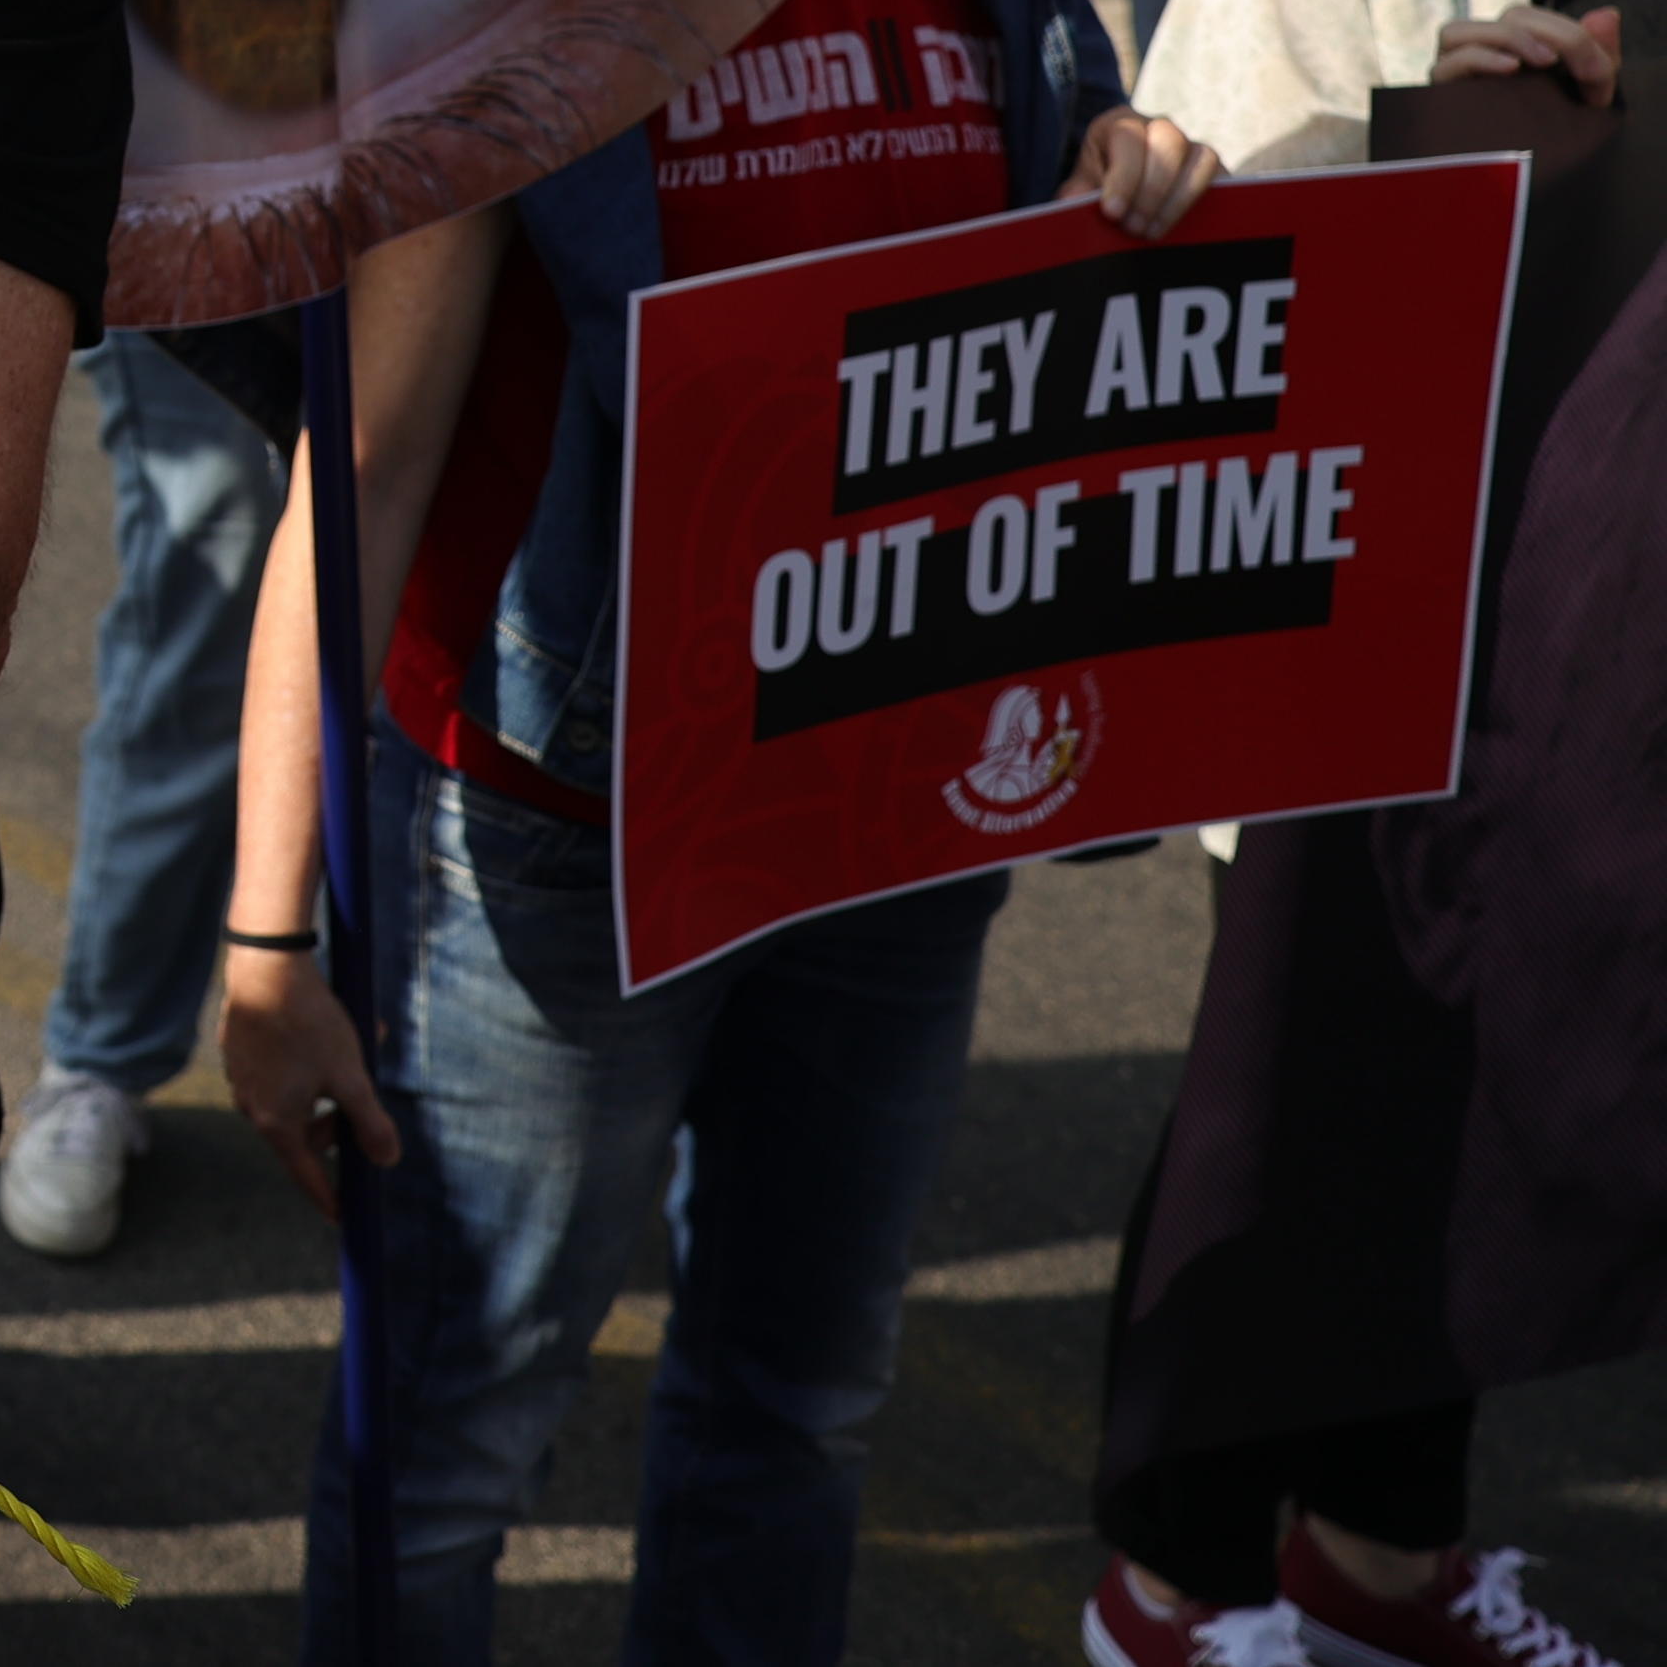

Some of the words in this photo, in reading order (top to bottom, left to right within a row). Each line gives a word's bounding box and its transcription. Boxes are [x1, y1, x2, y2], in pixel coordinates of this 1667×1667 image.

[665, 31, 881, 144] הנשים
[844, 127, 884, 164] לא
[837, 309, 1057, 476] THEY
[1084, 278, 1297, 418] ARE
[750, 515, 934, 674] OUT
[966, 480, 1080, 616] OF
[1118, 444, 1363, 585] TIME
